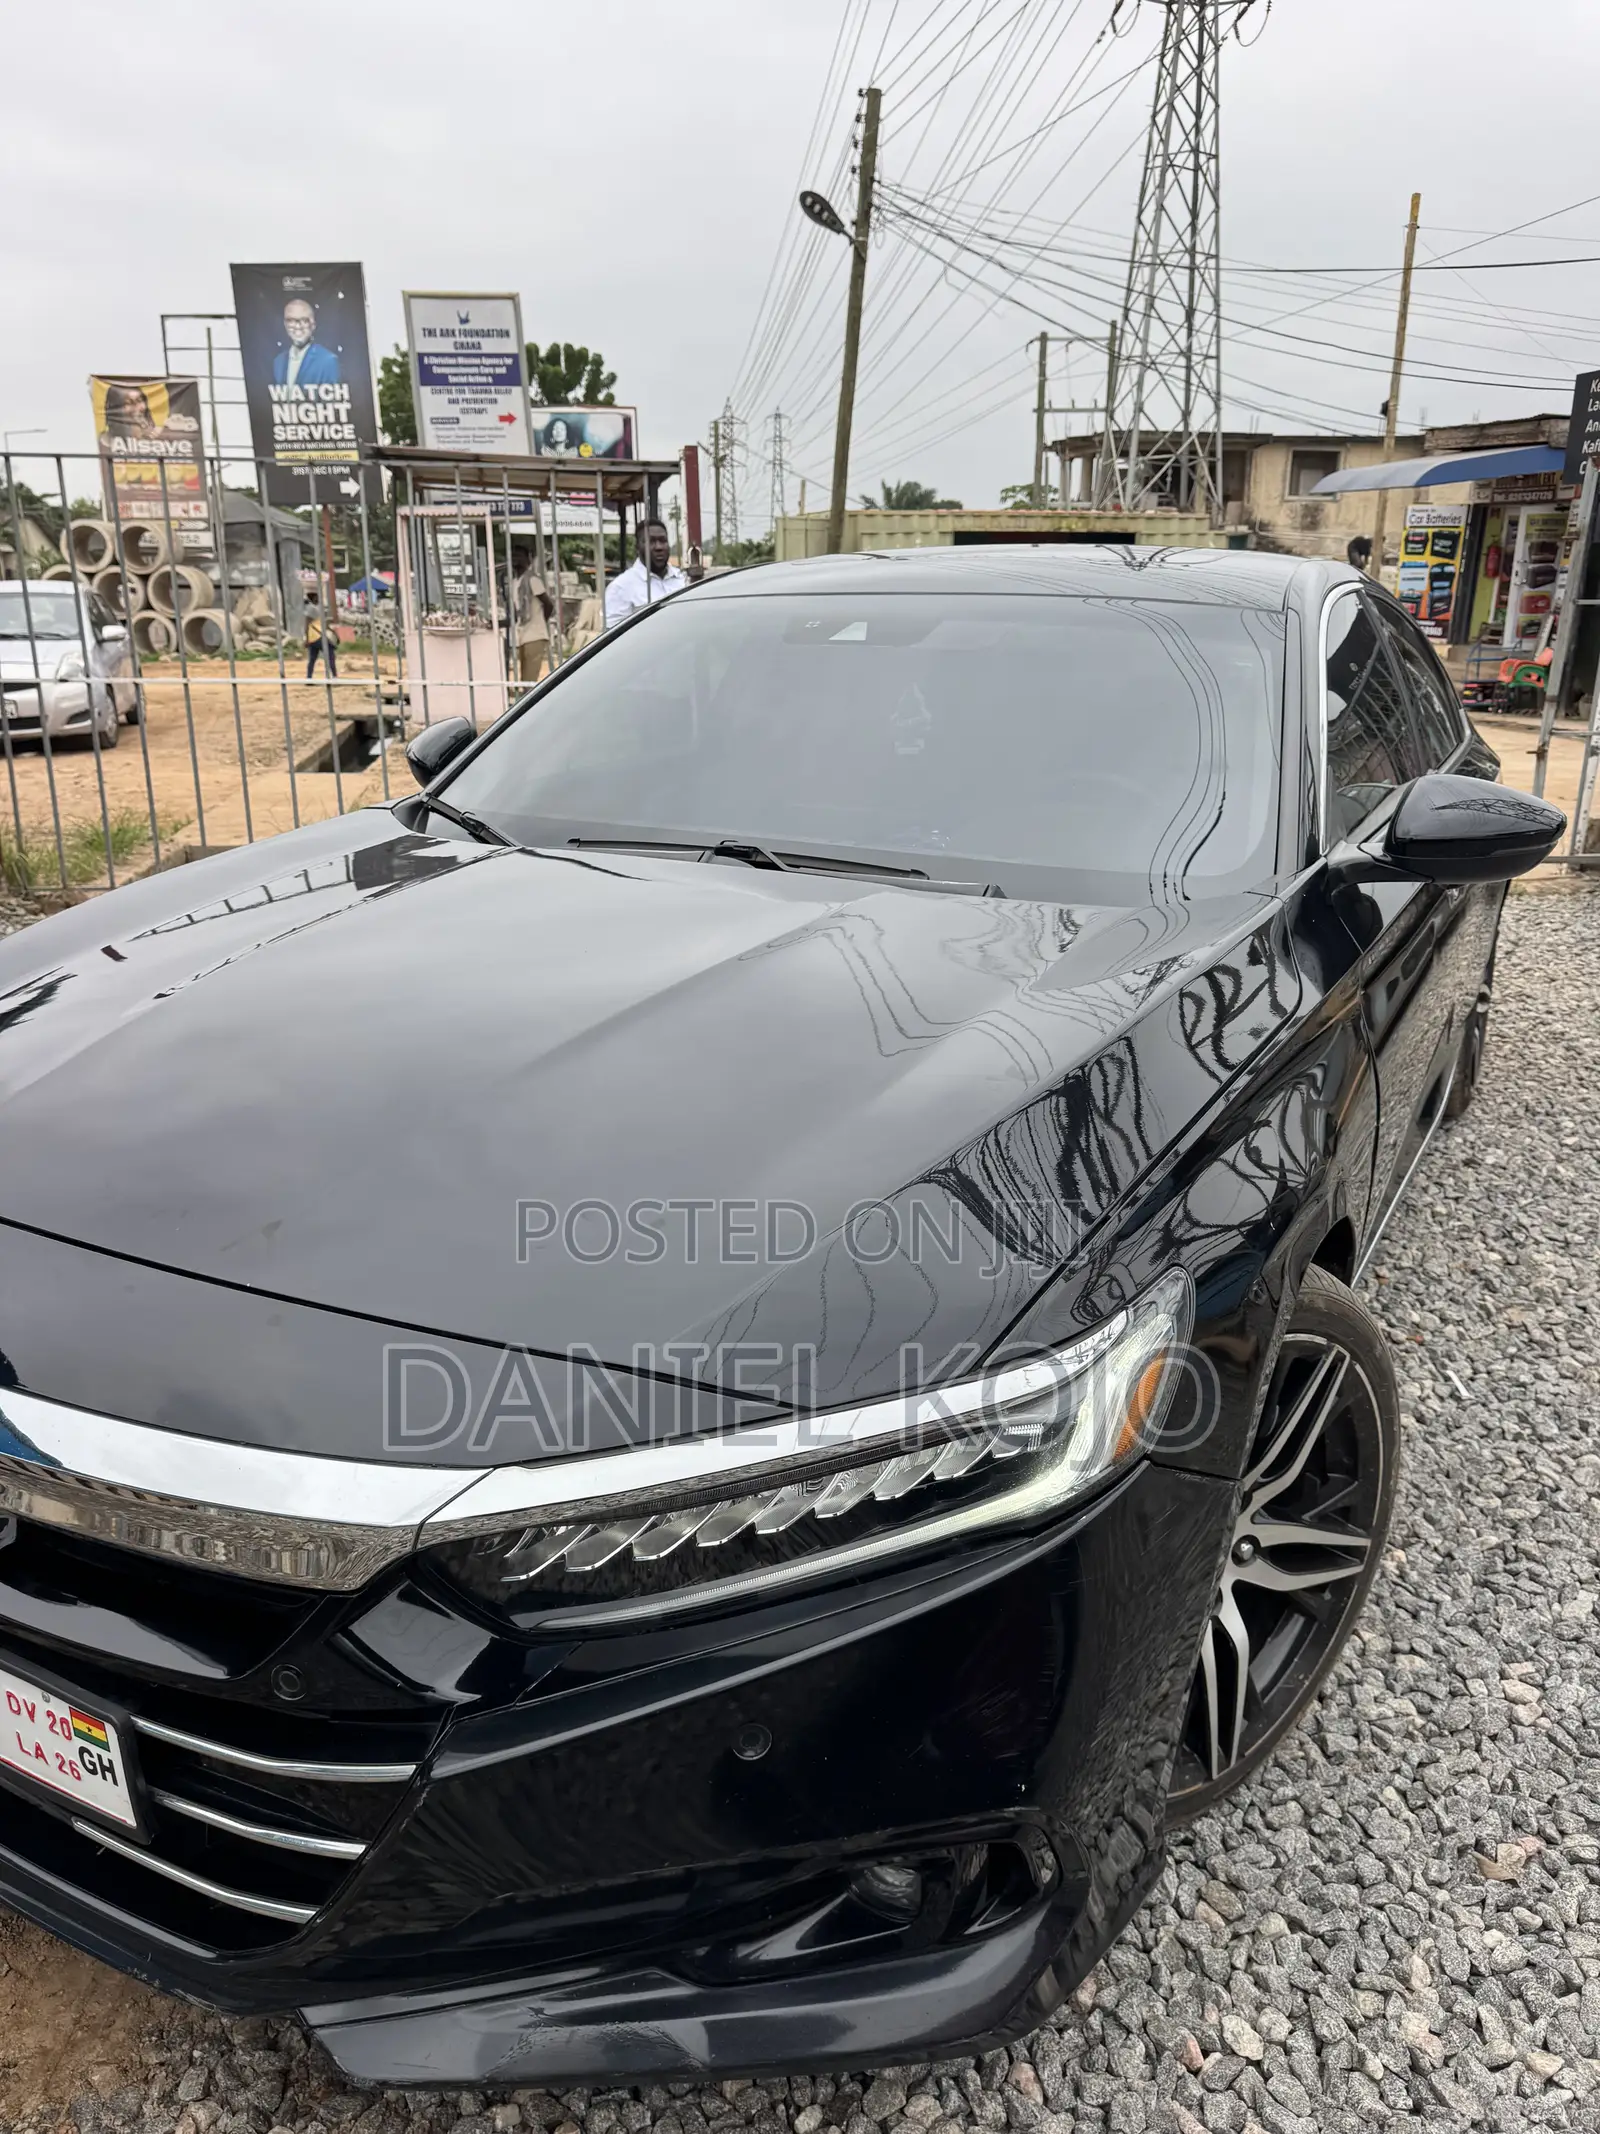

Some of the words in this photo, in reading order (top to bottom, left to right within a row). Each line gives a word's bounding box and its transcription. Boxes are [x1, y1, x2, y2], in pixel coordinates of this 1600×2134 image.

[439, 328, 457, 338] ARK
[459, 328, 511, 338] FOUNDATION
[453, 341, 482, 350] GHANA
[268, 384, 350, 402] WATCH
[272, 402, 351, 424] NIGHT
[273, 424, 356, 441] SERVICE
[111, 436, 193, 453] Allsave
[1425, 512, 1462, 524] Batteries
[6, 1690, 36, 1723] DV
[46, 1710, 72, 1741] 20
[16, 1731, 49, 1765] LA
[55, 1752, 81, 1781] 26
[78, 1745, 119, 1787] GH
